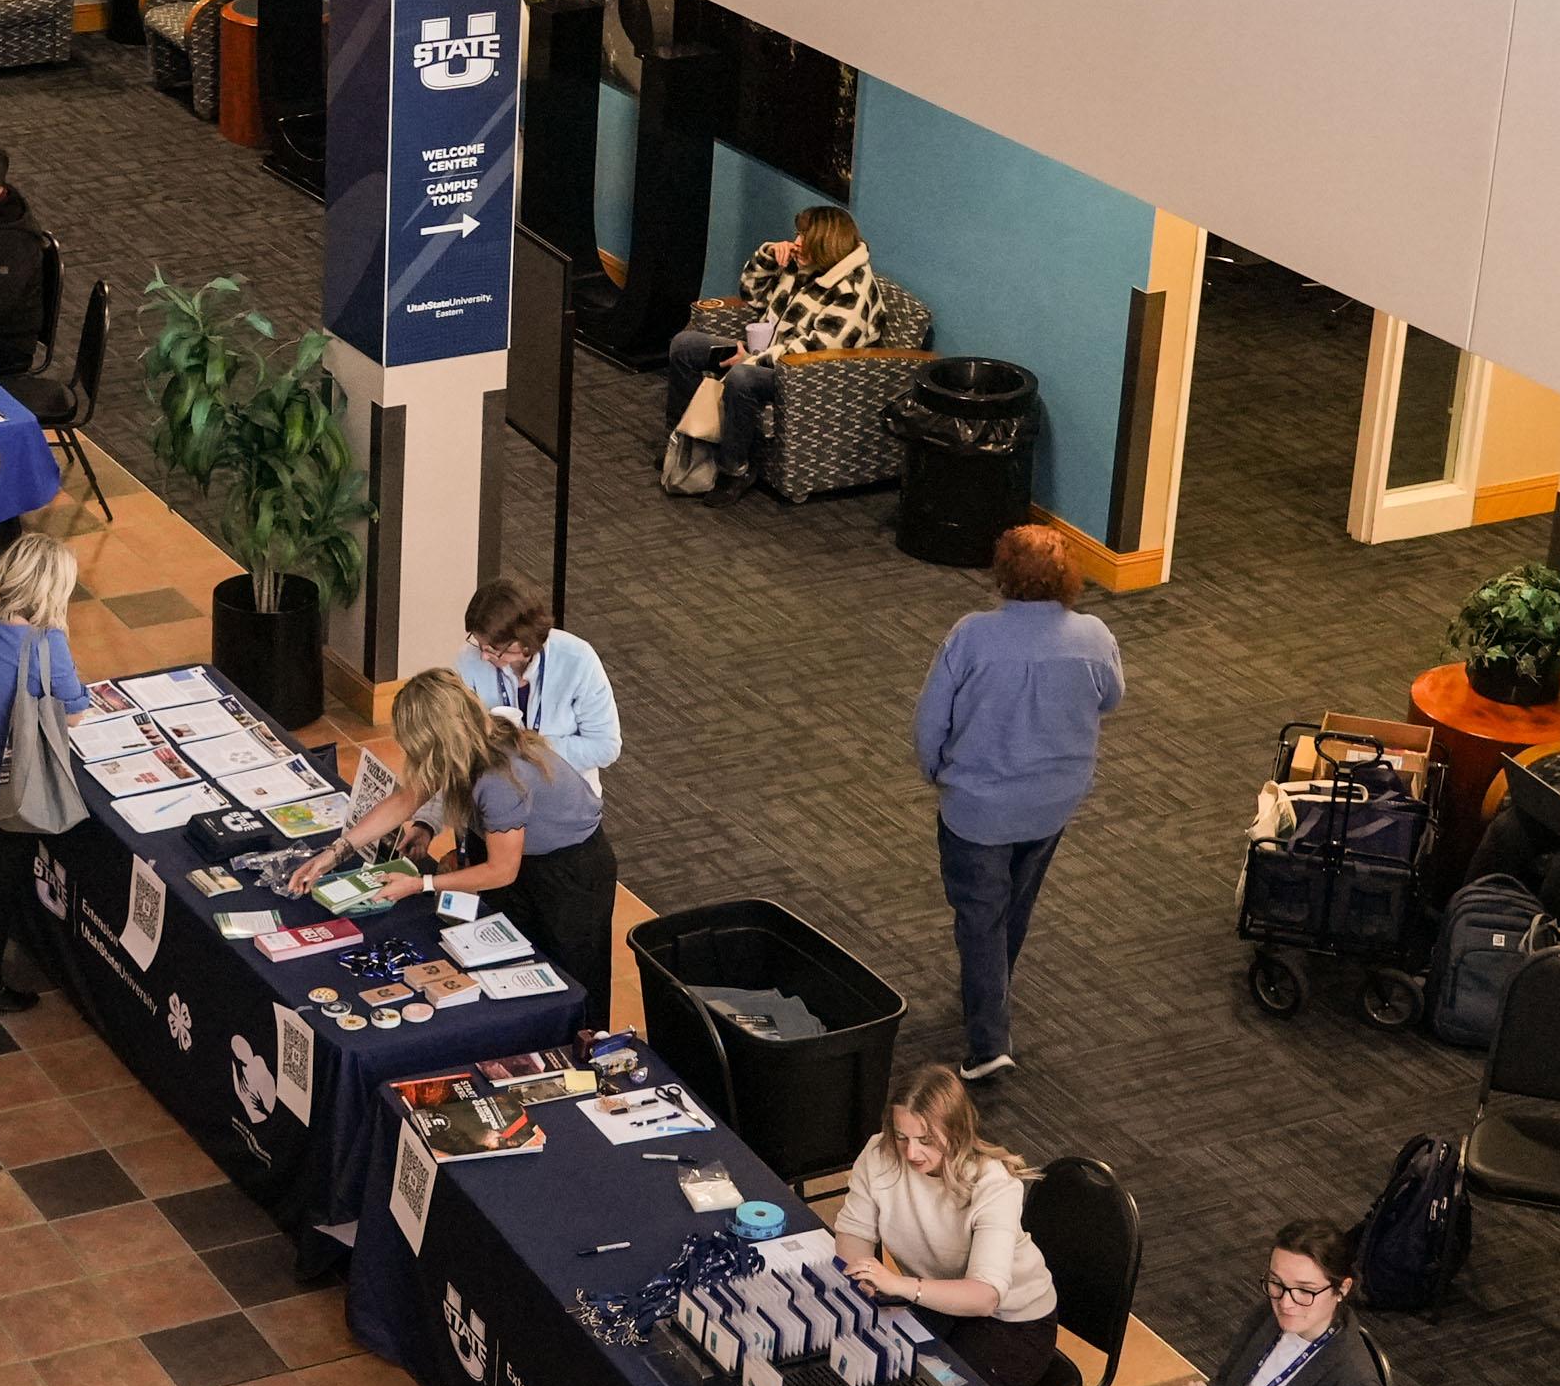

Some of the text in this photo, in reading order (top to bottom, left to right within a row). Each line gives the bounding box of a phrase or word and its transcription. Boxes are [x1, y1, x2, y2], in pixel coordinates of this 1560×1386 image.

[414, 34, 500, 69] STATE
[422, 143, 485, 162] WELCOME
[428, 157, 478, 173] CENTER
[426, 179, 478, 195] CAMPUS
[431, 192, 473, 207] TOURS
[435, 308, 464, 318] Eastern
[34, 856, 68, 907] STATE
[82, 898, 119, 948] Extension
[80, 922, 158, 1016] UtahStateUniversity
[460, 1080, 478, 1099] START
[443, 1299, 487, 1370] STATE
